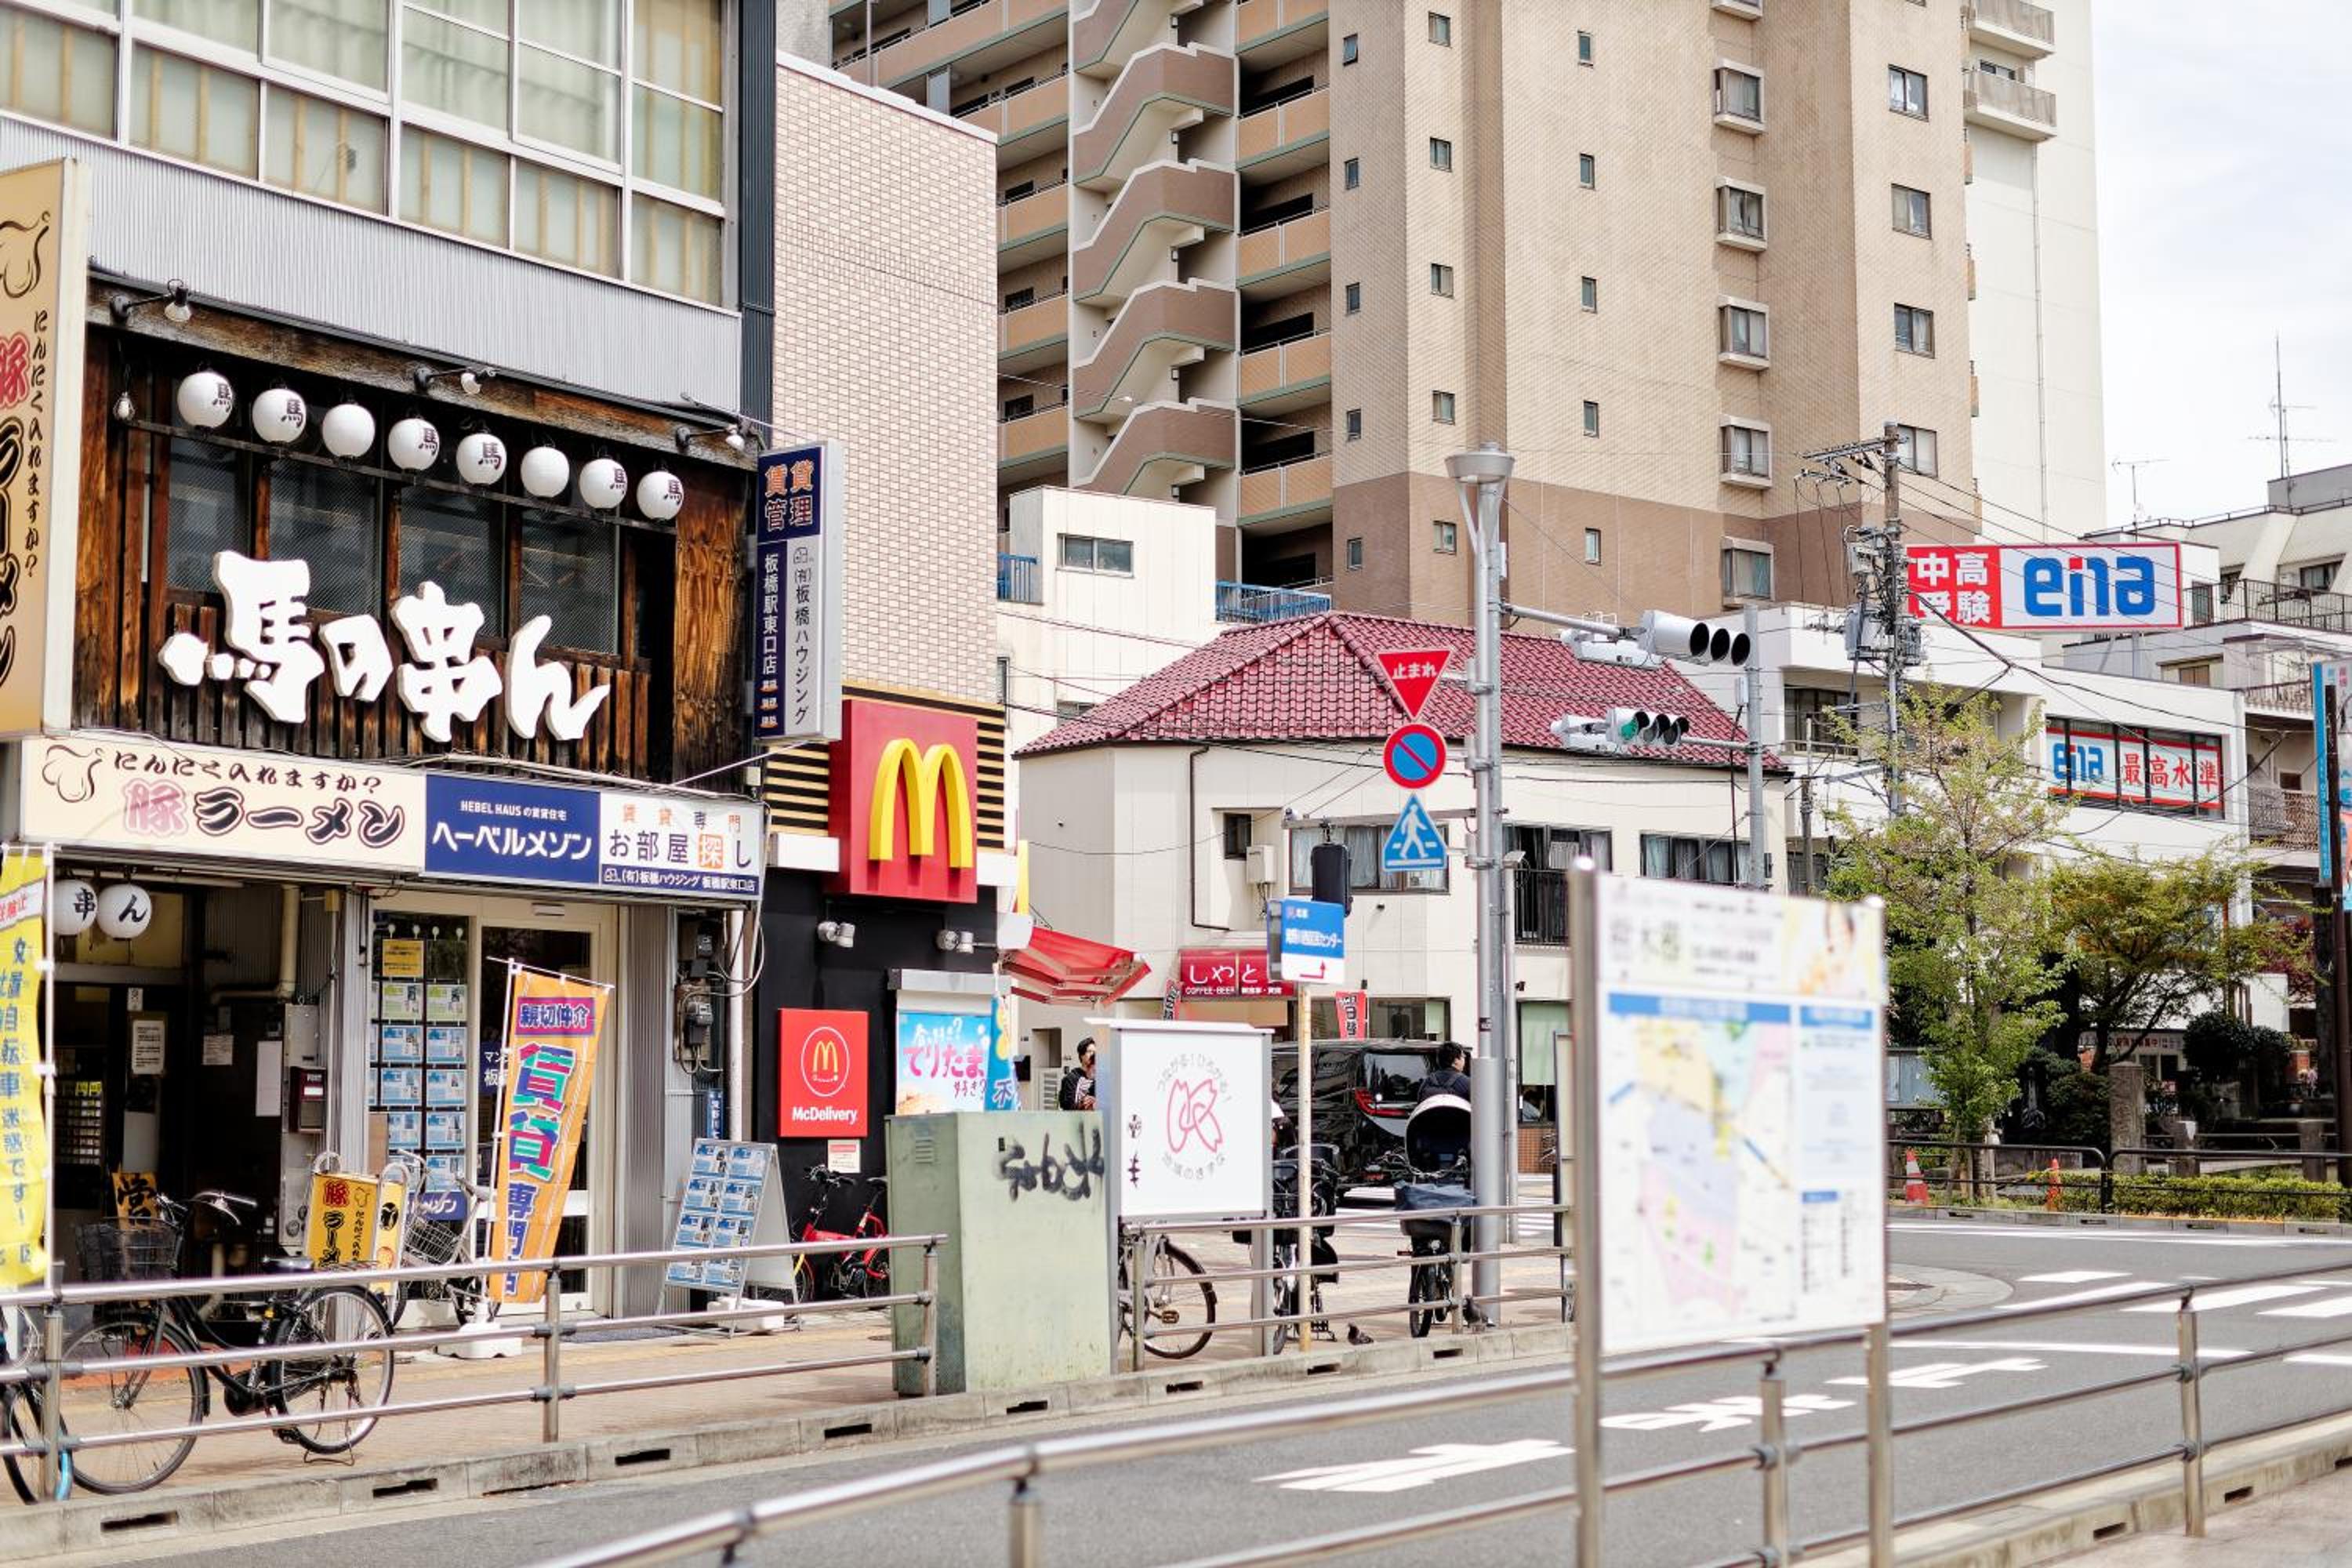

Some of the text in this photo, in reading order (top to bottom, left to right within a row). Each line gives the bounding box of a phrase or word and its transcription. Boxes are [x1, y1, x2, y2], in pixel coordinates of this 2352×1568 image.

[281, 398, 302, 427] 馬
[418, 427, 439, 456] 馬
[479, 441, 501, 470] 馬
[662, 478, 683, 506] 馬
[2024, 556, 2156, 617] ena
[763, 554, 779, 676] 板橋駅東口店
[1392, 662, 1437, 680] 止まれ
[2053, 742, 2103, 782] ena
[2122, 752, 2219, 793] 最高水準
[124, 777, 405, 848] 豚ラーメン
[460, 800, 493, 815] HEBEL
[495, 802, 521, 816] HAUS
[432, 821, 592, 860] ヘーベルメゾン
[608, 829, 752, 870] お部屋探し
[74, 886, 148, 924] 串 ん
[518, 1003, 590, 1029] 親切仲介
[902, 1043, 985, 1079] てりたま
[792, 1106, 858, 1125] McDelivery
